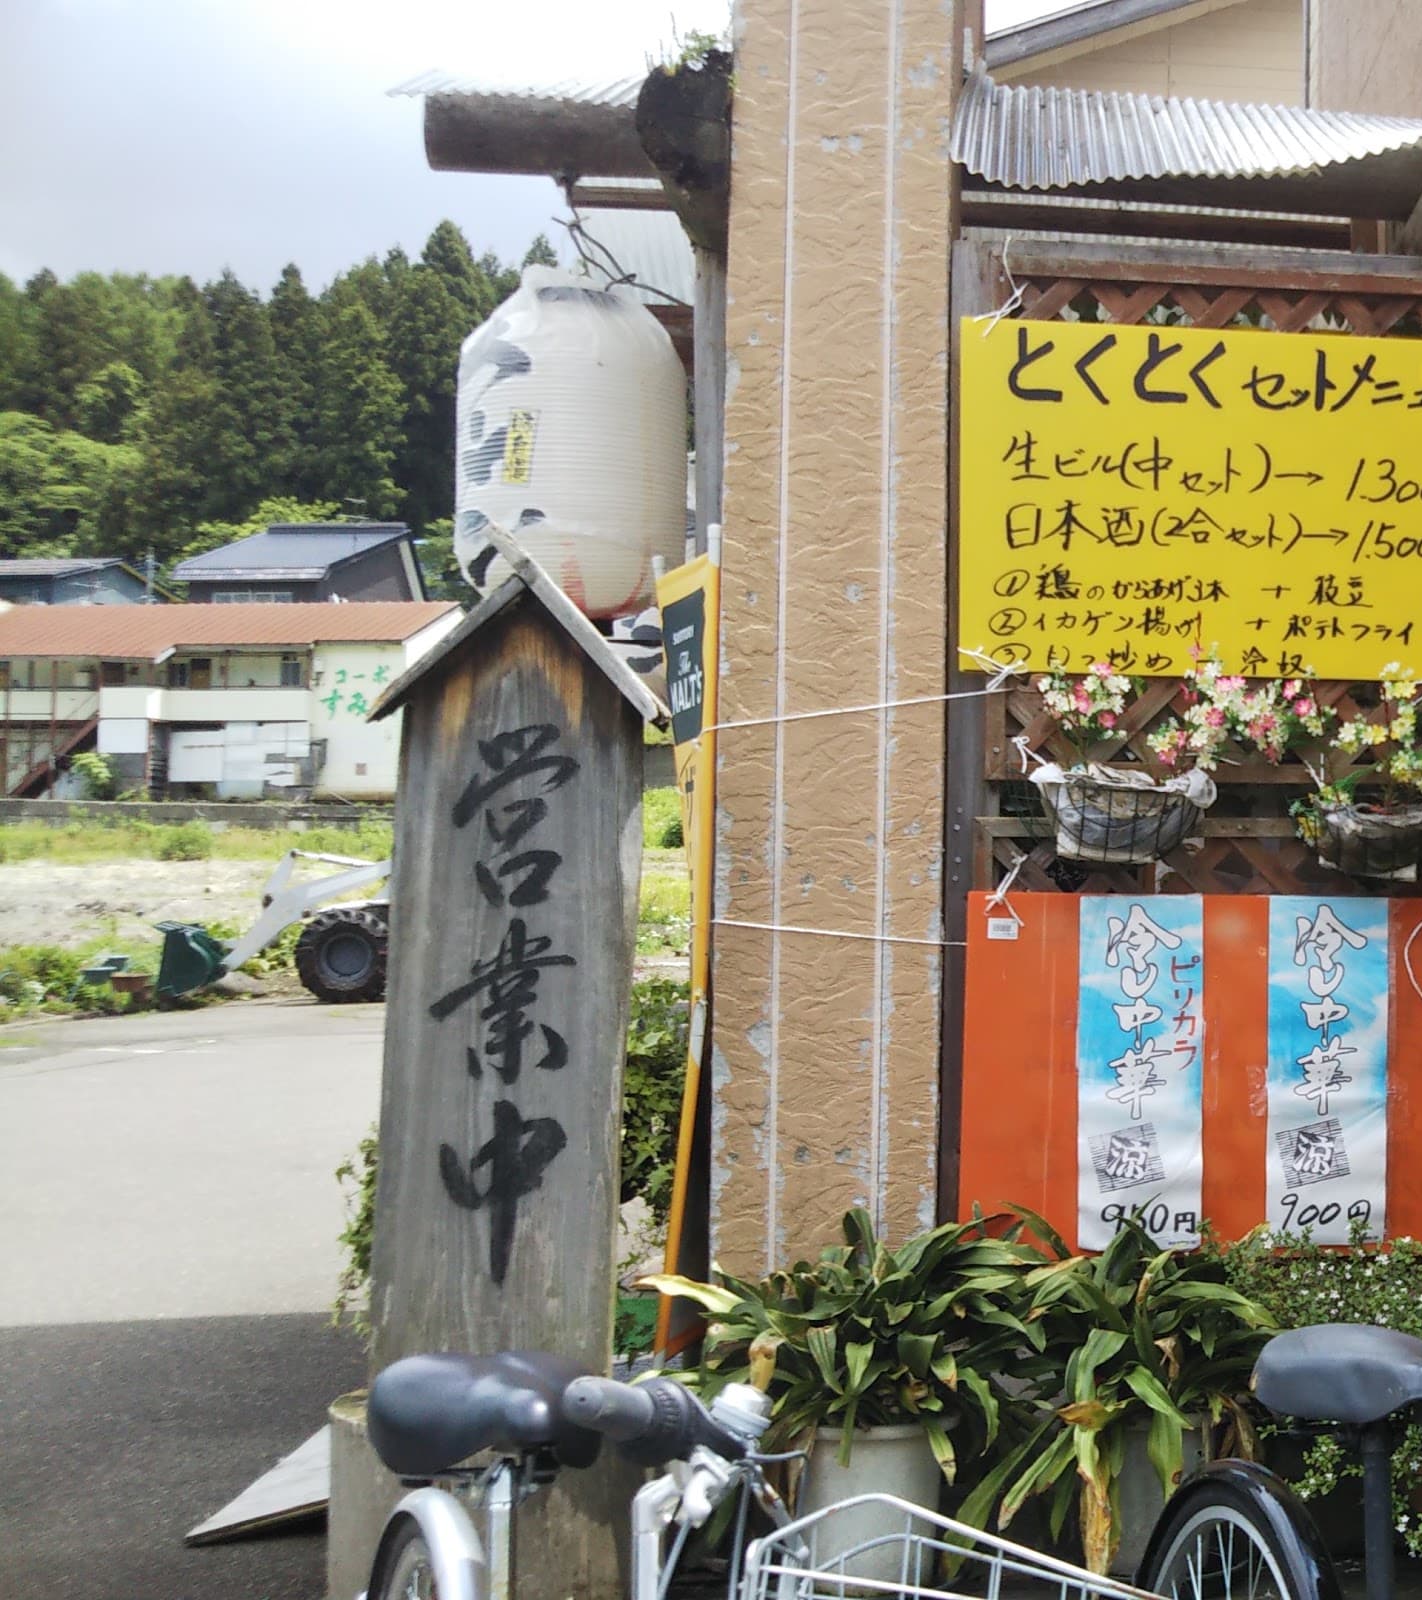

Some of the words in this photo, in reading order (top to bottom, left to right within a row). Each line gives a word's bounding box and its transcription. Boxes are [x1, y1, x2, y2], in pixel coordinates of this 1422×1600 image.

[1282, 614, 1414, 646] ポテトフライ
[429, 722, 581, 1288] 営業中
[1105, 904, 1183, 1121] 冷し中華
[1171, 955, 1201, 1071] ピリカラ
[1294, 904, 1367, 1116] 冷し中華
